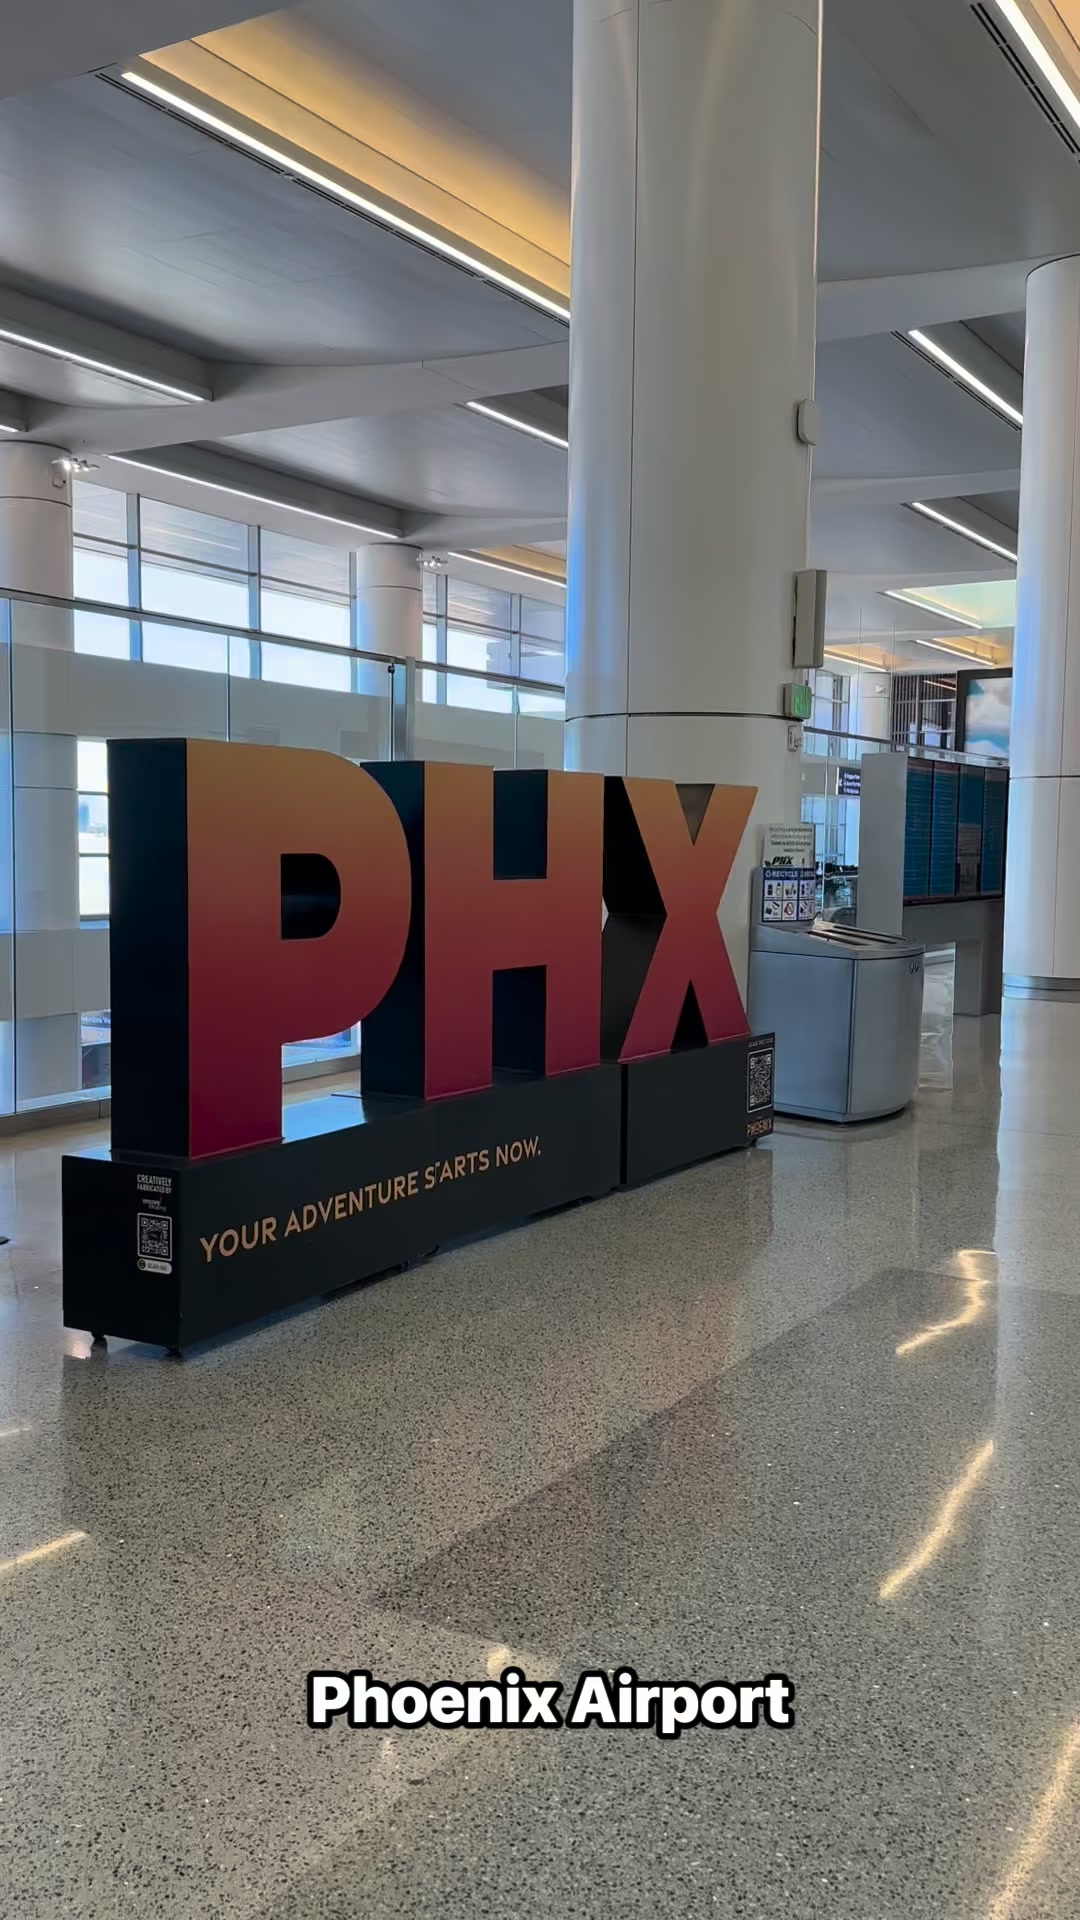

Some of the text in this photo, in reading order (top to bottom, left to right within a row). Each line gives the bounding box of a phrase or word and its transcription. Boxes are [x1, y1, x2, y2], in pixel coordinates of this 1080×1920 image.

[186, 738, 758, 1160] PHX
[137, 1173, 172, 1187] CREATIVELY
[200, 1136, 542, 1263] YOUR ADVENTURE STARTS NOW.
